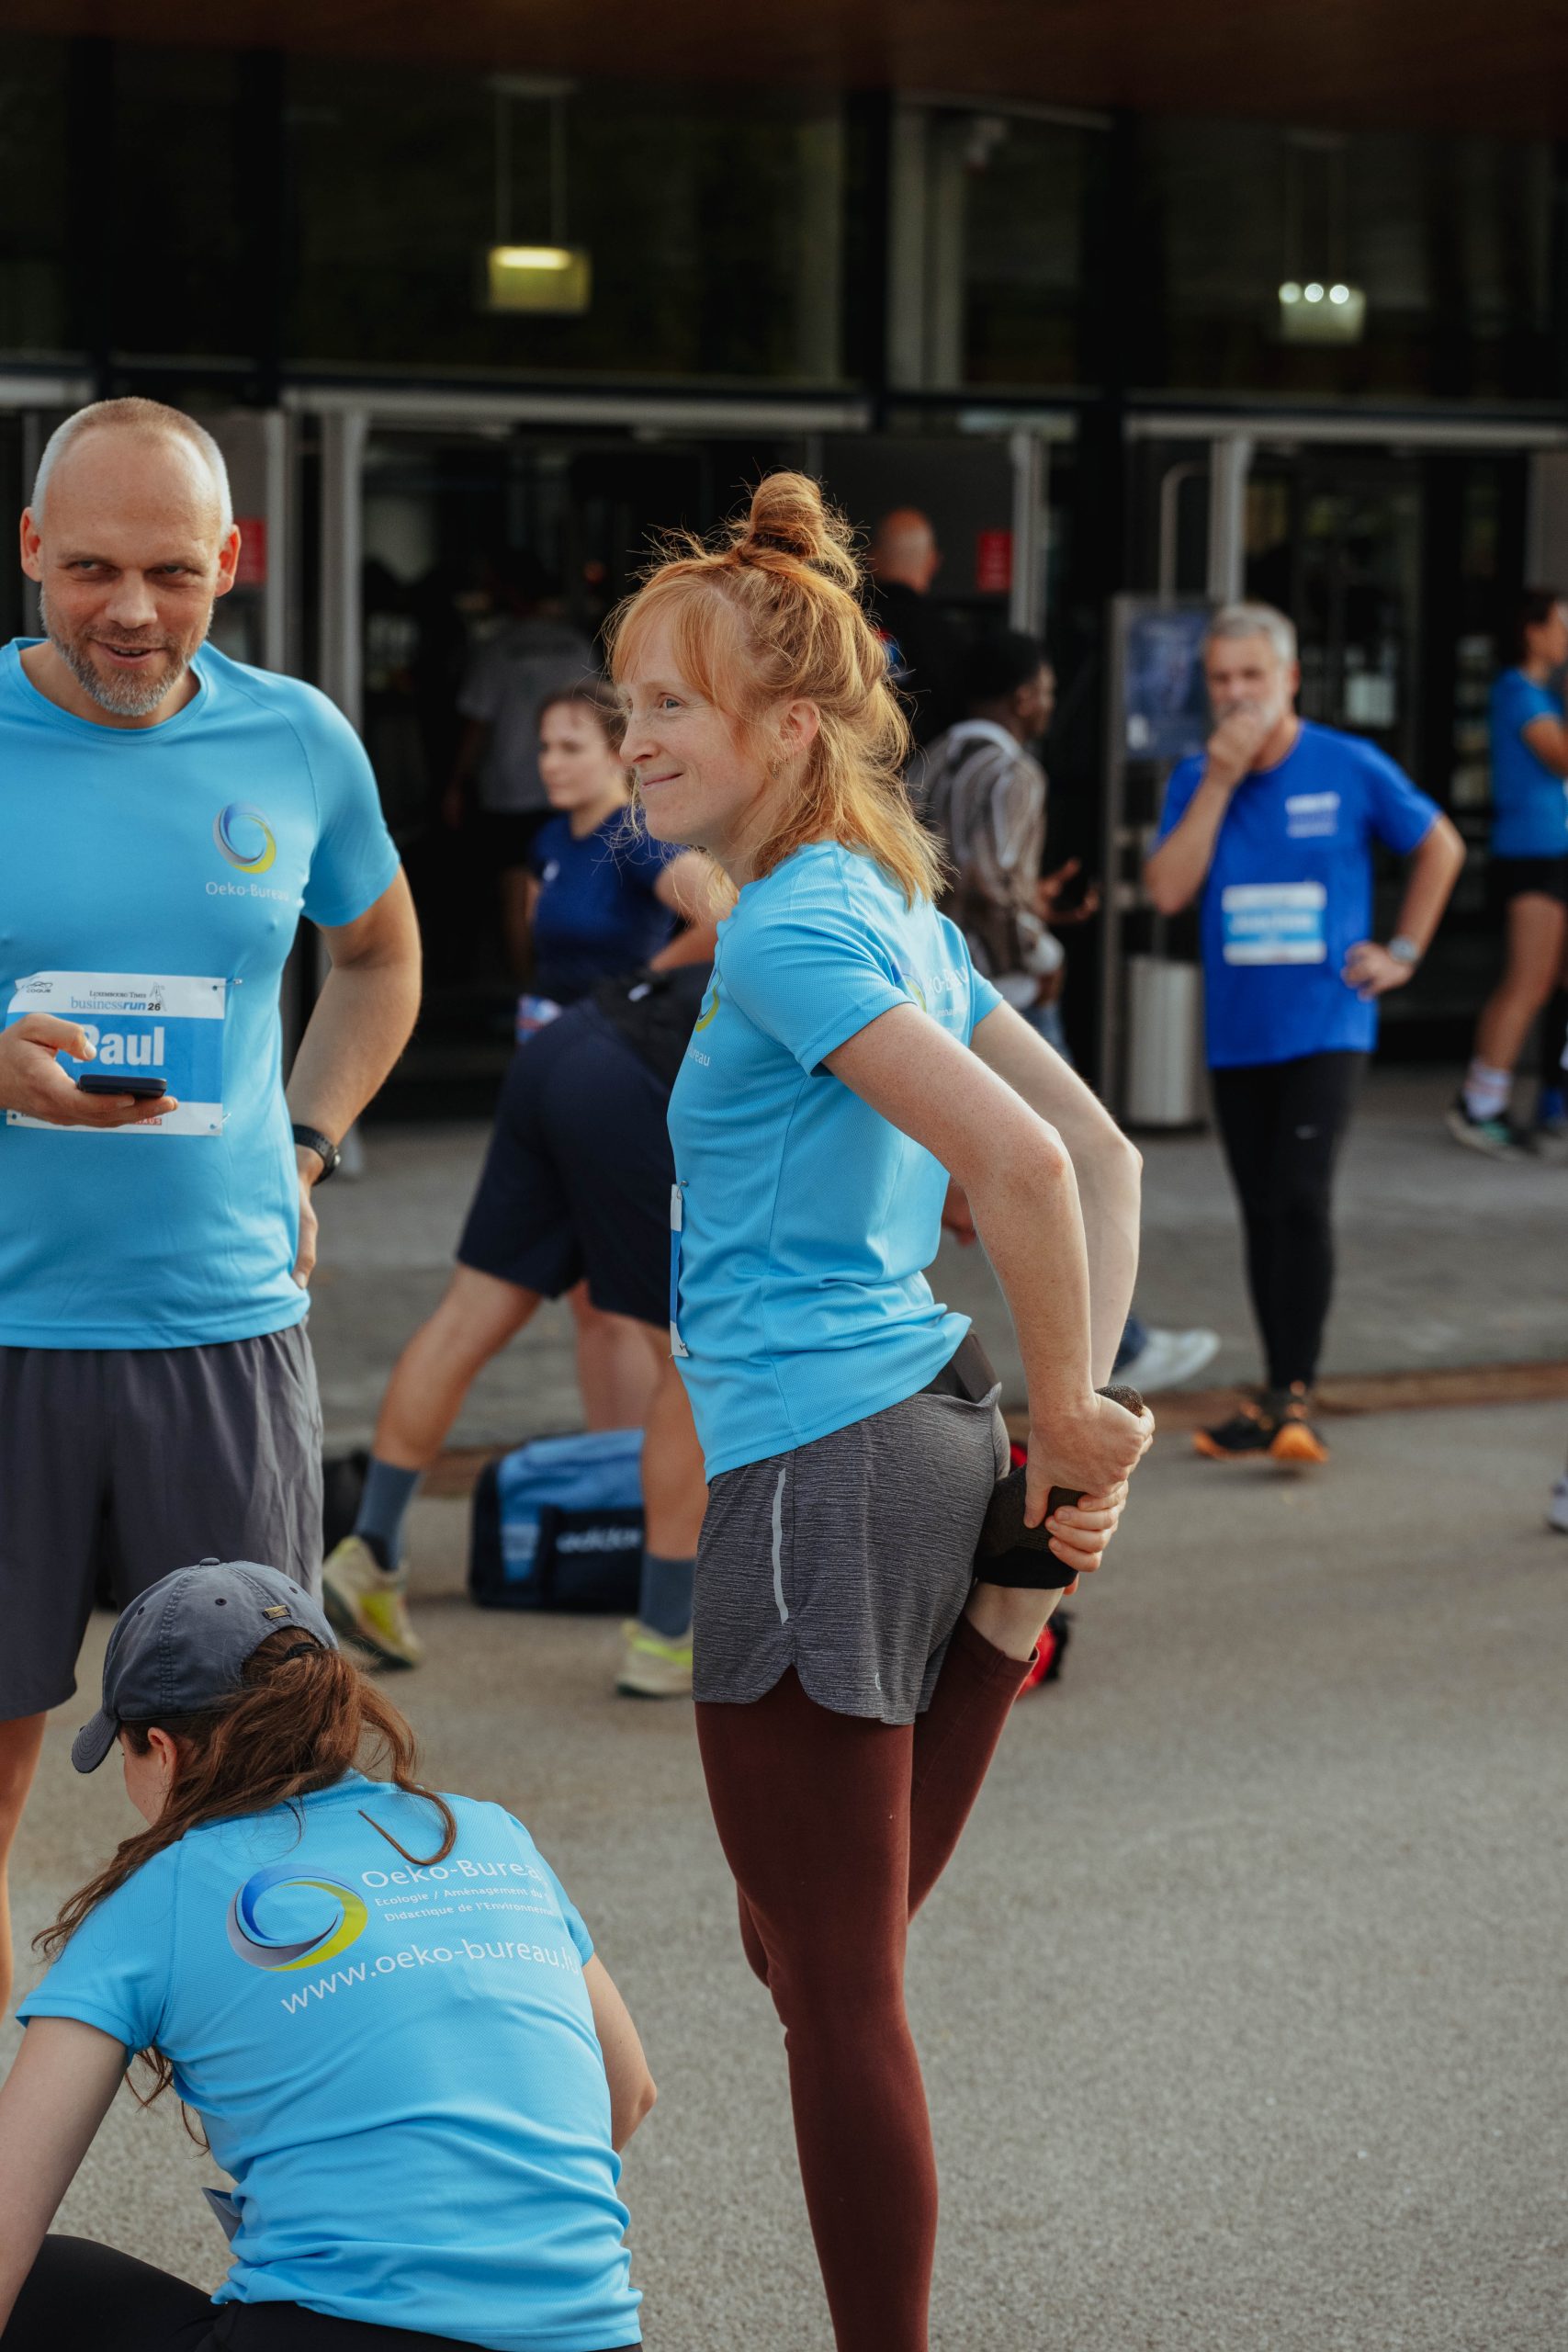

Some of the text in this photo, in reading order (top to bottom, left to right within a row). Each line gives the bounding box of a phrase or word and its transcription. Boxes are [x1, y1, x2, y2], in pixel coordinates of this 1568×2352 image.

[147, 1002, 161, 1012] 26
[361, 1860, 547, 1888] Oeko-Burea
[374, 1893, 429, 1906] Ecologie
[384, 1906, 455, 1922] Didactique
[457, 1903, 474, 1912] de
[281, 1939, 579, 2014] www.oeko-bureau.lu
